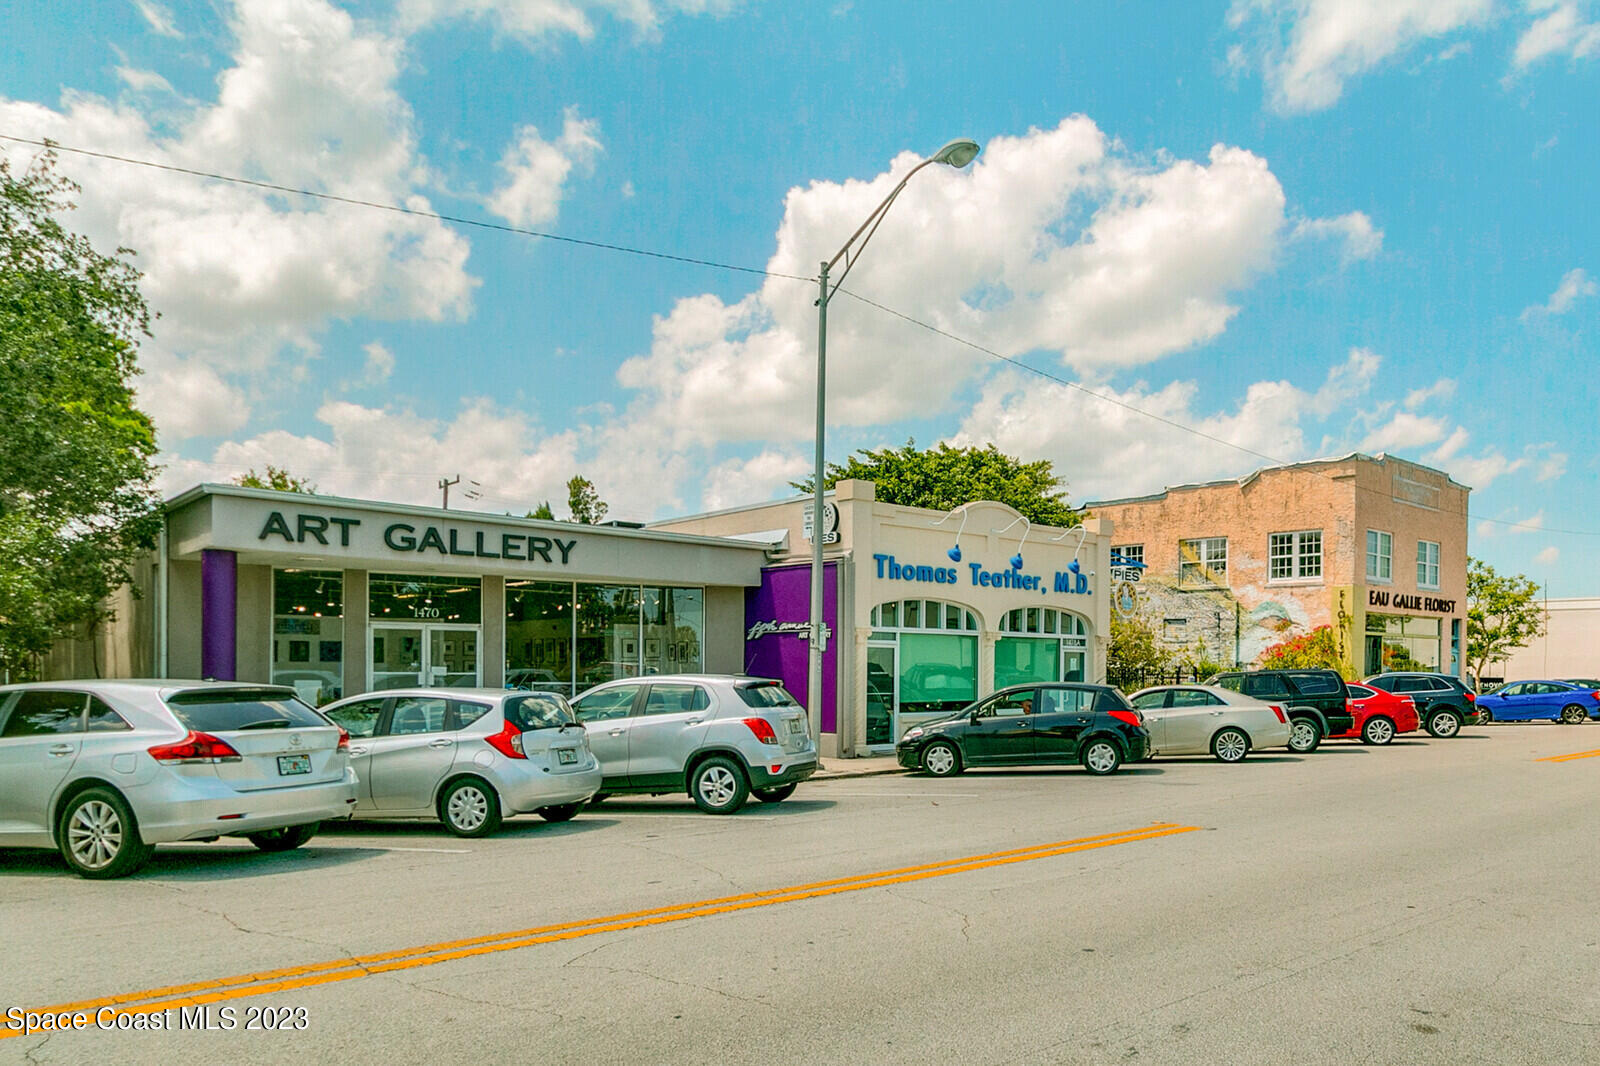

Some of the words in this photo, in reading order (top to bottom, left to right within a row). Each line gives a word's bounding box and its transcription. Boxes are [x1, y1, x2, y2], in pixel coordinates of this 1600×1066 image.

[259, 511, 361, 547] ART
[384, 523, 577, 564] GALLERY
[873, 553, 958, 585] Thomas
[969, 562, 1047, 595] Teather,
[1054, 571, 1093, 596] M.D.
[1113, 569, 1141, 582] PIES
[413, 607, 440, 618] 1470
[1369, 590, 1390, 607] EAU
[1393, 593, 1422, 611] GALLIE
[1424, 597, 1456, 613] FLORIST
[1337, 589, 1346, 660] FLORIST
